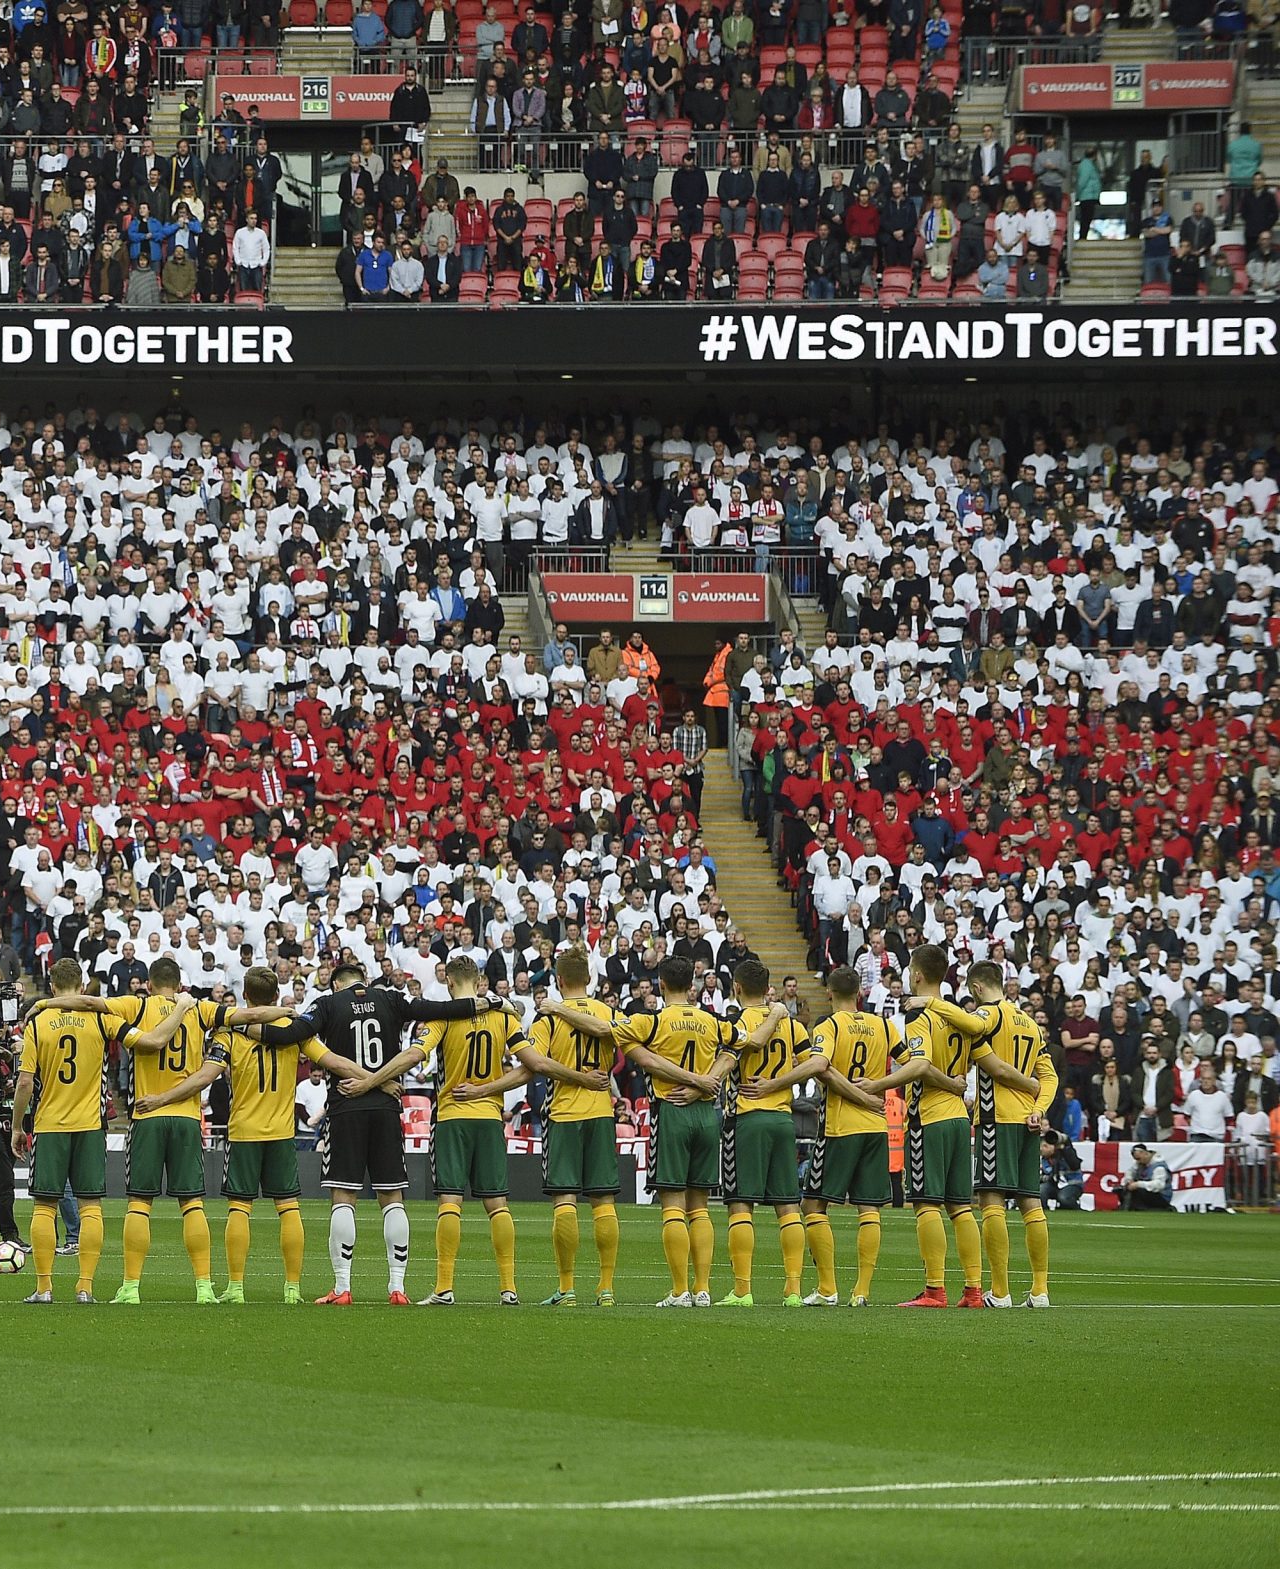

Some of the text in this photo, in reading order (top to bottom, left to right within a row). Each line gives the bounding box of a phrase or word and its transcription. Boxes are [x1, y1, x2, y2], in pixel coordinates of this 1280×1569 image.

[1040, 82, 1108, 92] VAUXHALL
[1115, 72, 1140, 86] 217
[1161, 79, 1230, 90] VAUXHALL
[233, 92, 296, 102] VAUXHALL
[303, 84, 328, 97] 216
[348, 92, 394, 102] VAUXH
[560, 592, 629, 603] VAUXHALL
[641, 583, 667, 597] 114
[691, 592, 760, 603] VAUXHALL
[49, 1015, 86, 1031] SLAVICKAS
[669, 1020, 708, 1036] KIJANSKAS
[156, 1022, 188, 1073] 19
[349, 1018, 384, 1069] 16
[569, 1028, 601, 1072] 14
[58, 1034, 78, 1085] 3
[465, 1029, 492, 1080] 10
[679, 1040, 697, 1074] 4
[847, 1041, 868, 1084] 8
[946, 1033, 963, 1079] 2
[1012, 1034, 1035, 1075] 17
[251, 1044, 278, 1093] 11
